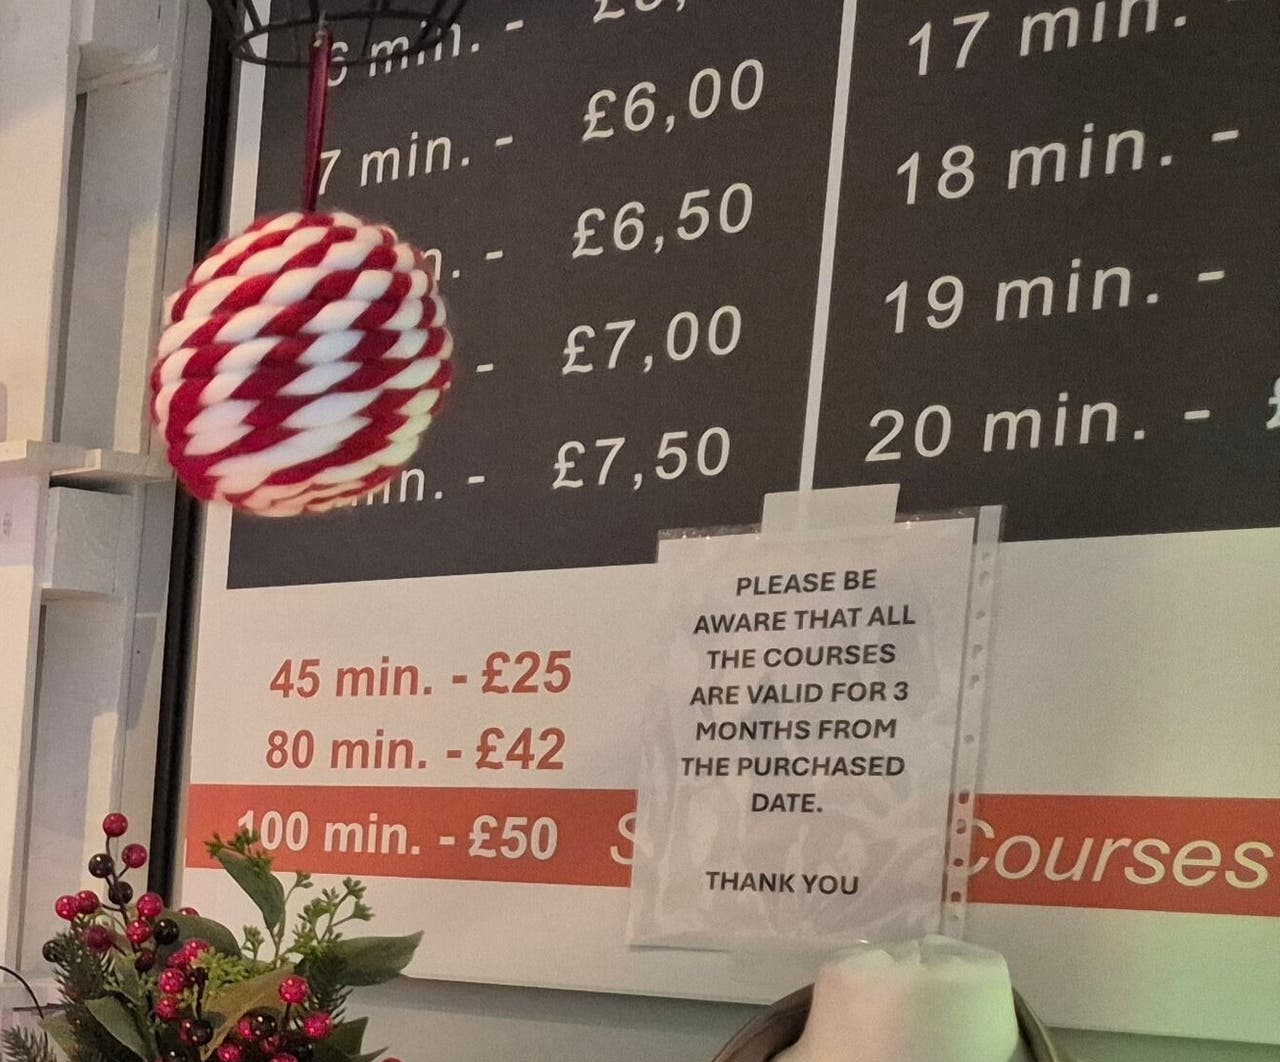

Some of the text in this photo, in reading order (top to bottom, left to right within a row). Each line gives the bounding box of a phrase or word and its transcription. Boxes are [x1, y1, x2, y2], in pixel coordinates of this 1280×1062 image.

[907, 0, 1188, 77] 17 min.
[318, 148, 341, 196] 7
[360, 131, 470, 187] min.
[581, 58, 765, 142] £6,00
[896, 144, 975, 206] 18
[1006, 122, 1173, 190] min.
[571, 182, 754, 260] £6,50
[884, 274, 965, 334] 19
[994, 257, 1160, 322] min.
[561, 304, 742, 375] £7,00
[864, 403, 953, 463] 20
[982, 391, 1146, 453] min.
[552, 426, 731, 490] £7,50
[735, 568, 878, 598] PLEASE BE
[693, 604, 917, 635] AWARE THAT ALL
[268, 657, 321, 699] 45
[335, 655, 433, 698] min.
[480, 649, 572, 696] £25
[706, 643, 898, 670] THE COURSES
[688, 679, 910, 706] ARE VALID FOR 3
[265, 729, 316, 770] 80
[329, 728, 427, 770] min.
[474, 726, 566, 770] £42
[695, 717, 898, 742] MONTHS FROM
[681, 754, 907, 778] THE PURCHASED
[750, 792, 824, 814] DATE.
[237, 809, 310, 852] 100
[323, 812, 421, 856] min.
[467, 813, 559, 861] £50
[705, 870, 860, 896] THANK YOU
